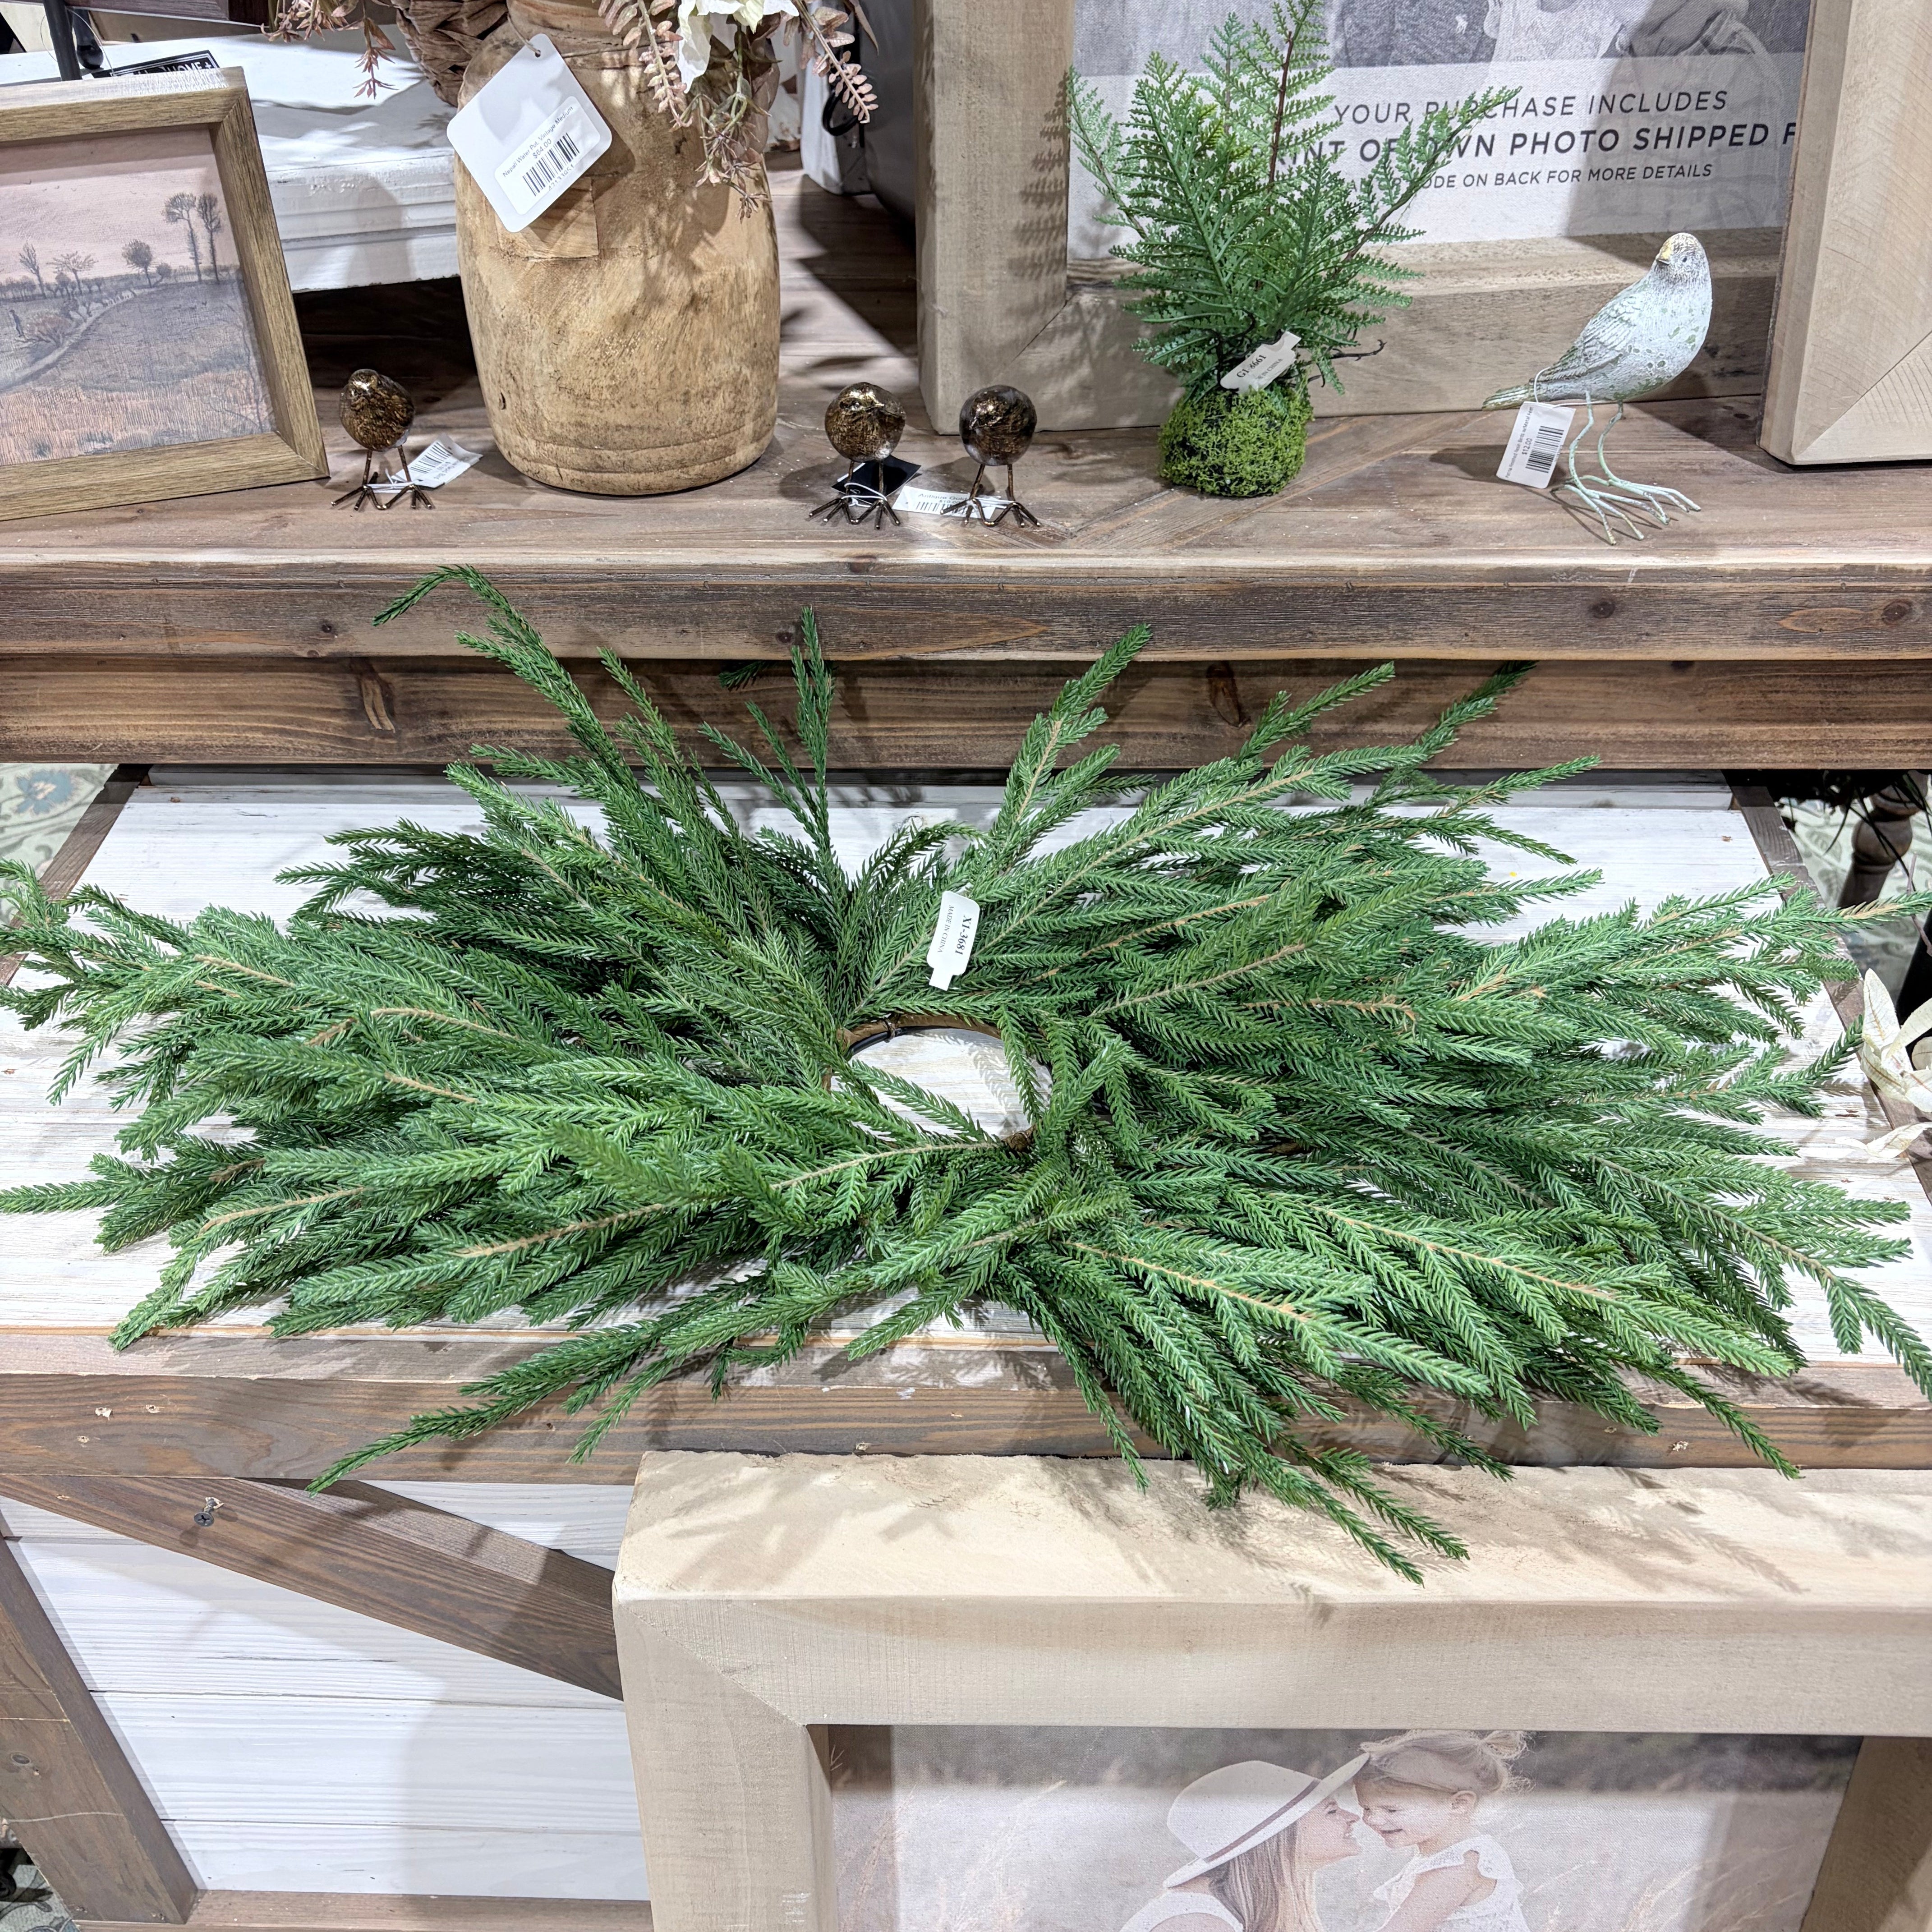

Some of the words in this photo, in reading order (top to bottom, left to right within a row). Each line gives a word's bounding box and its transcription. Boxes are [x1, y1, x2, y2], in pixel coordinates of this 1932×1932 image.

[1334, 103, 1410, 124] YOUR
[1588, 91, 1728, 115] INCLUDES
[516, 150, 530, 163] Water
[538, 124, 556, 141] Vintage
[555, 106, 573, 125] Medium
[533, 138, 552, 159] $64.00
[1252, 141, 1345, 166] INT
[1509, 129, 1620, 156] PHOTO
[1633, 123, 1769, 151] SHIPPED
[1421, 175, 1457, 189] ODE
[1463, 173, 1488, 187] ON
[1494, 170, 1541, 186] BACK
[1547, 169, 1582, 184] FOR
[1587, 166, 1637, 182] MORE
[1642, 164, 1713, 180] DETAILS
[946, 905, 954, 924] MADE
[938, 932, 948, 953] CHINA
[955, 915, 972, 955] X1-3681
